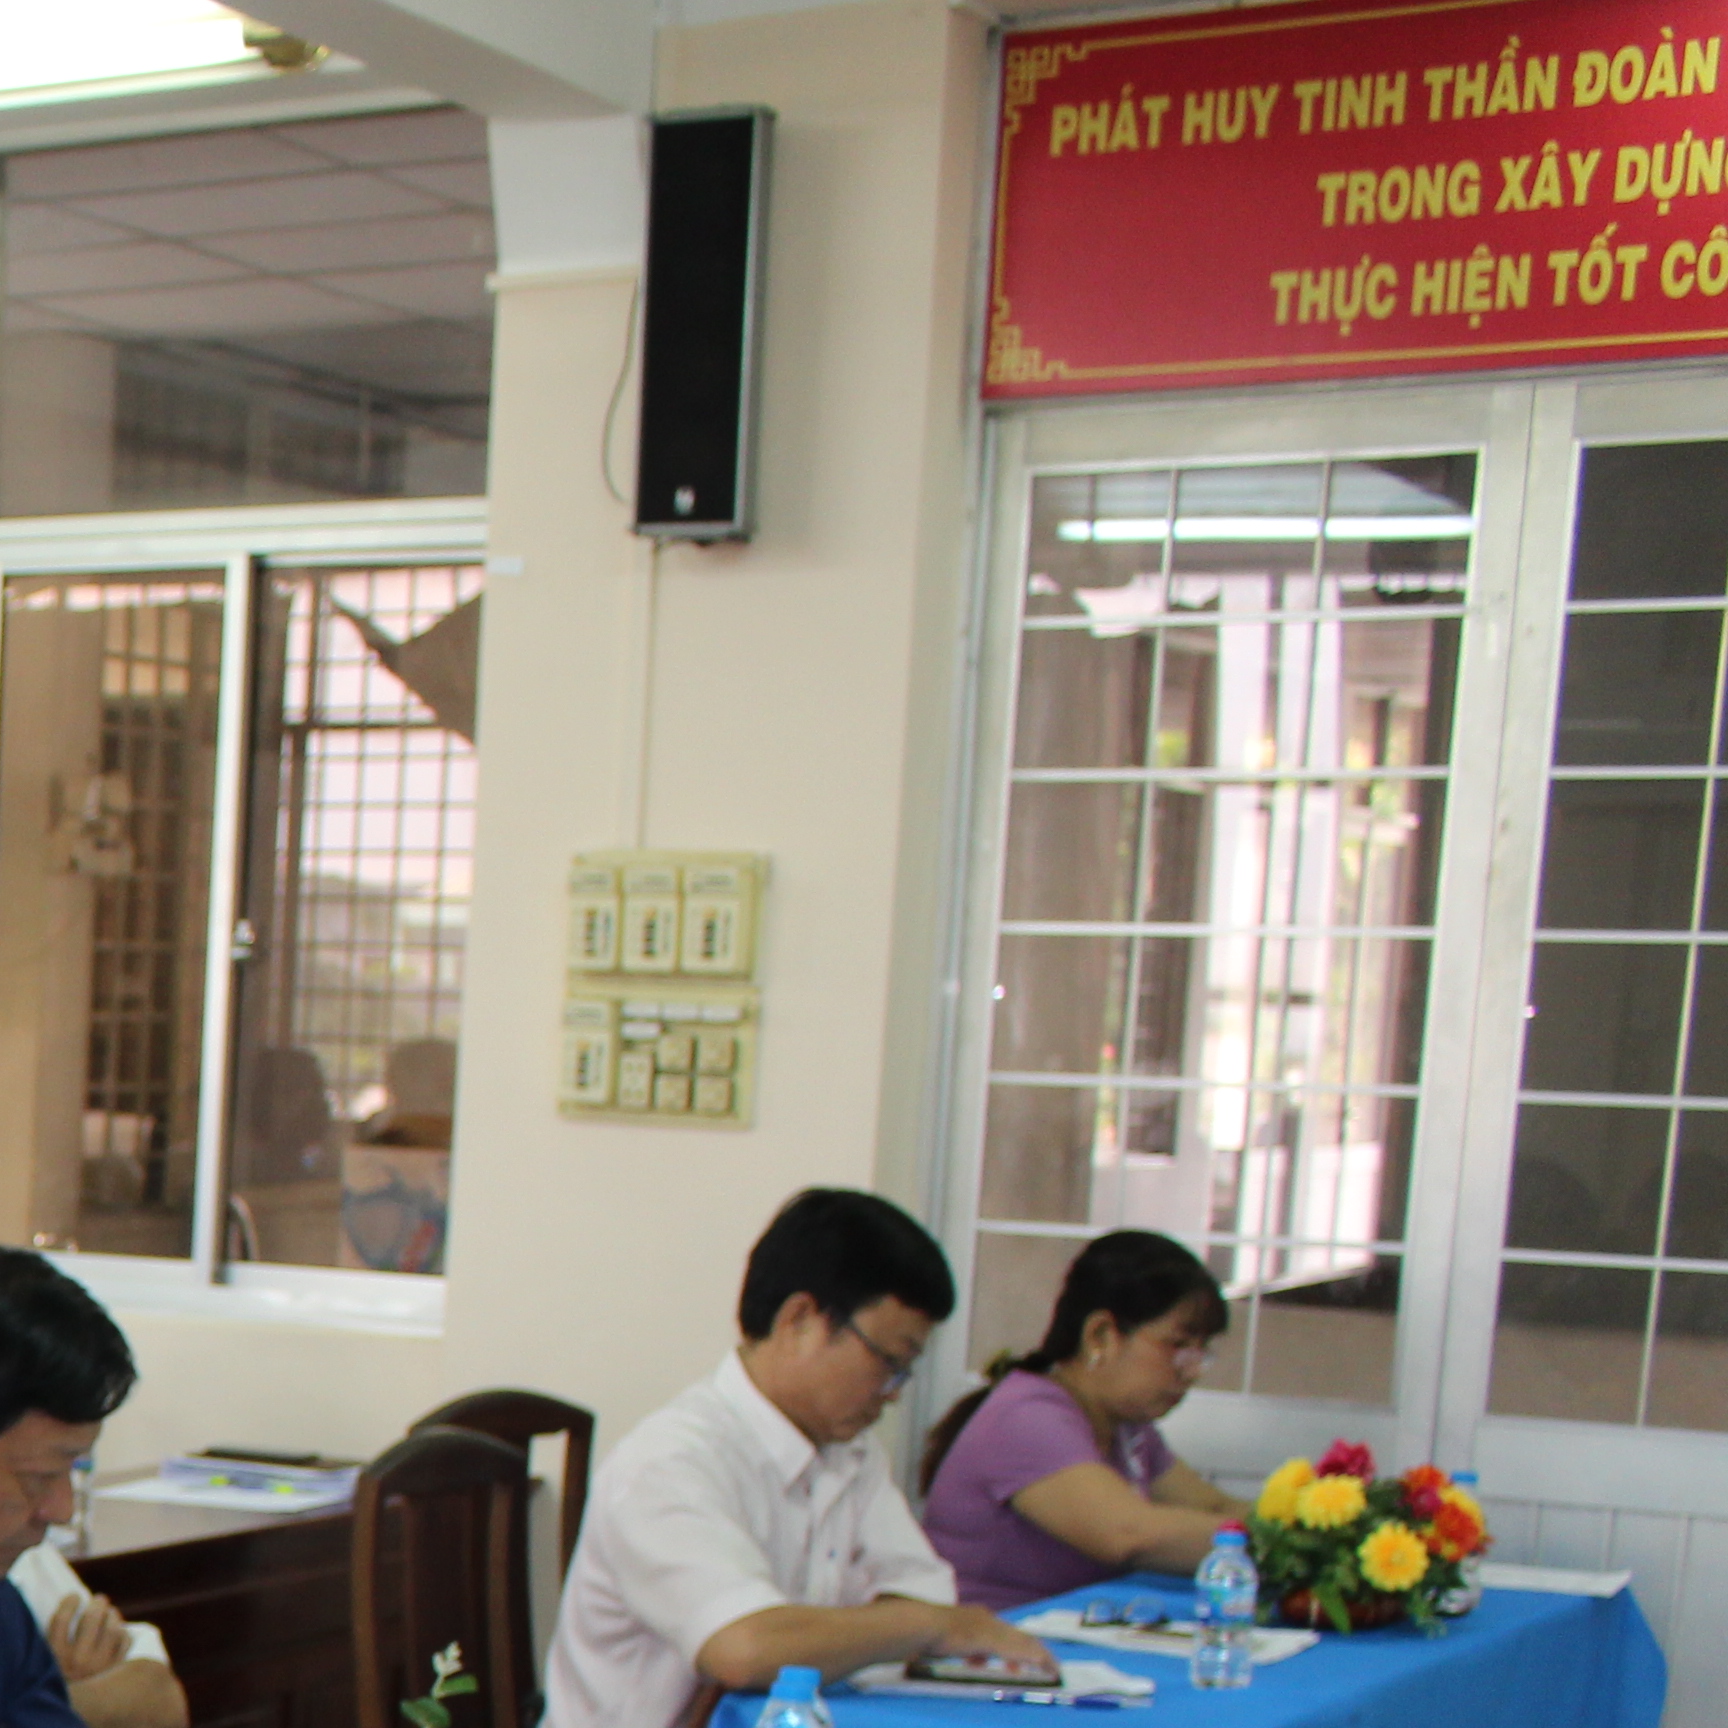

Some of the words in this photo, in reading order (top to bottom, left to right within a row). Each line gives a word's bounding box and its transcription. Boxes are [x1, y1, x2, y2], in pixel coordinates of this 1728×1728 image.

[1049, 82, 1170, 157] PHÁT
[1181, 83, 1280, 146] HUY
[1293, 70, 1408, 135] TINH
[1423, 35, 1560, 122] THẦN
[1573, 26, 1721, 107] ĐOÀN
[1317, 159, 1481, 227] TRONG
[1495, 139, 1602, 213] XÂY
[1613, 128, 1728, 216] DỰN
[1270, 253, 1398, 337] THỰC
[1411, 243, 1532, 329] HIỆN
[1547, 222, 1648, 306] TỐT
